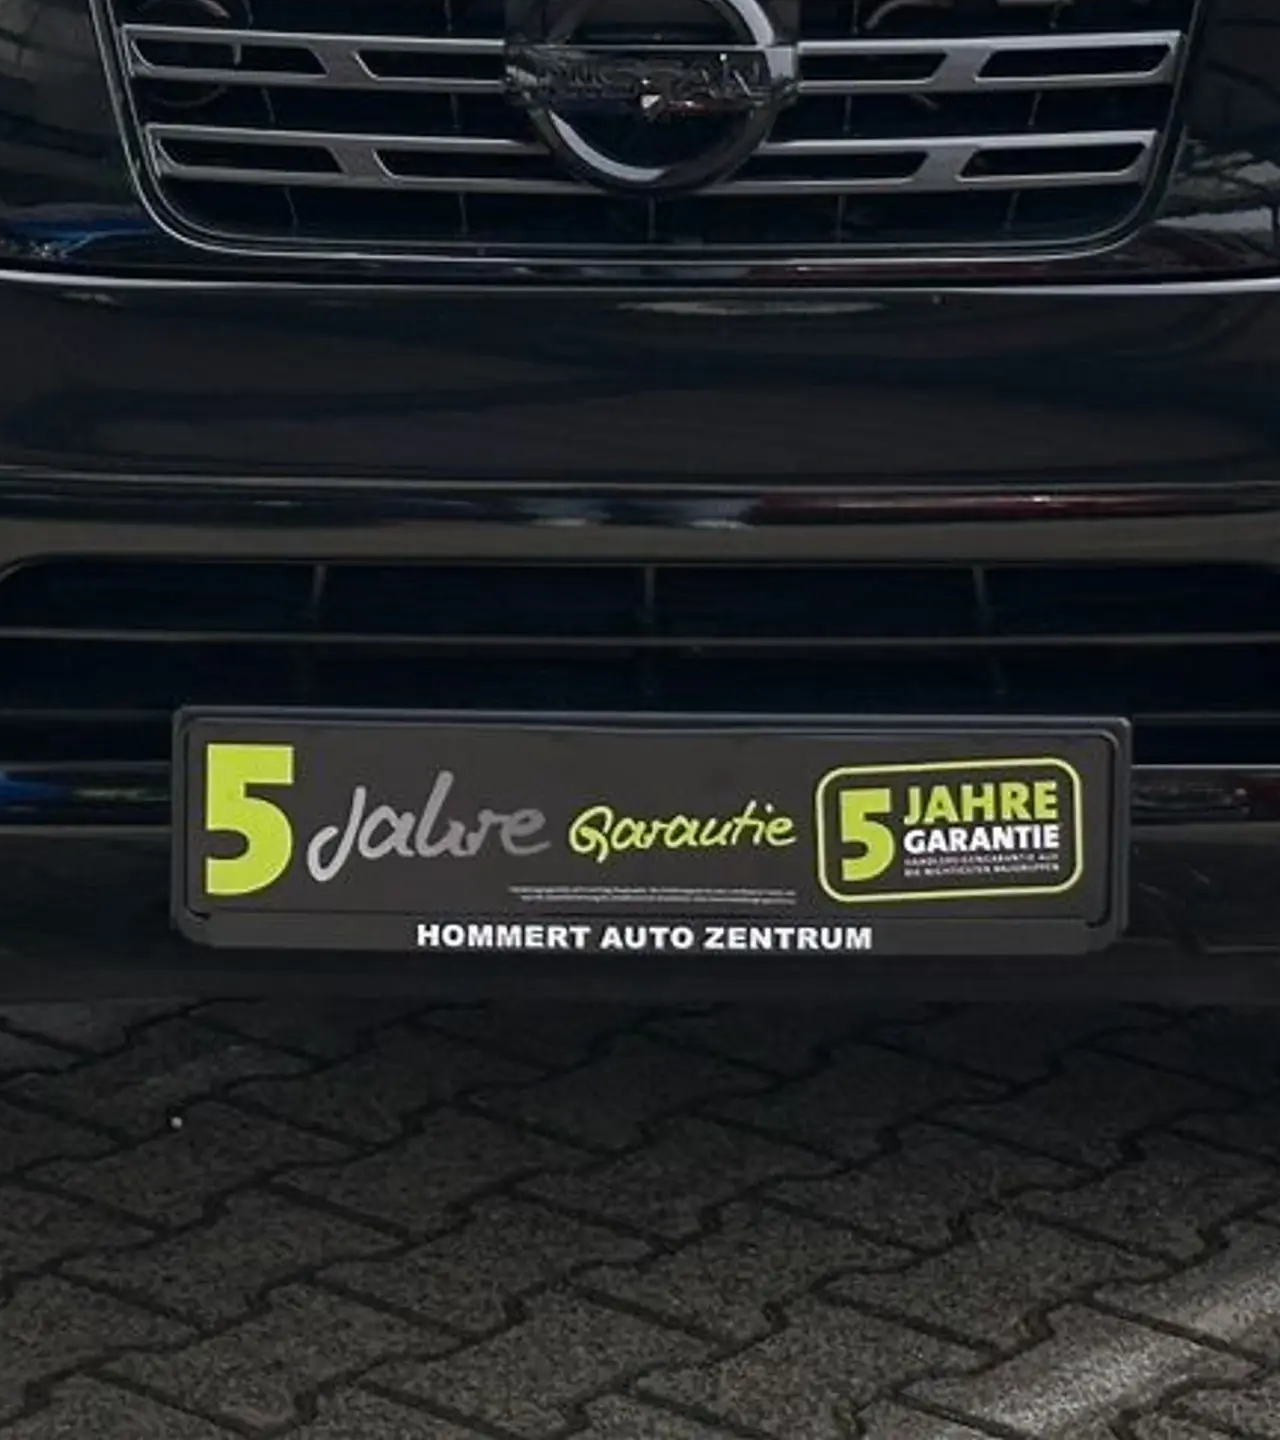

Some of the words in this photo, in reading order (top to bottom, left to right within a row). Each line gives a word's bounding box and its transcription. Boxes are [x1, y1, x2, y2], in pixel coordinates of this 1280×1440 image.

[207, 744, 293, 895] 5
[308, 771, 551, 882] Jahre
[569, 799, 796, 863] Garantie
[904, 781, 1059, 825] JAHRE
[840, 788, 895, 881] 5
[904, 824, 1060, 854] GARANTIE
[418, 924, 591, 949] HOMMERT
[601, 926, 694, 950] AUTO
[704, 926, 872, 950] ZENTRUM
